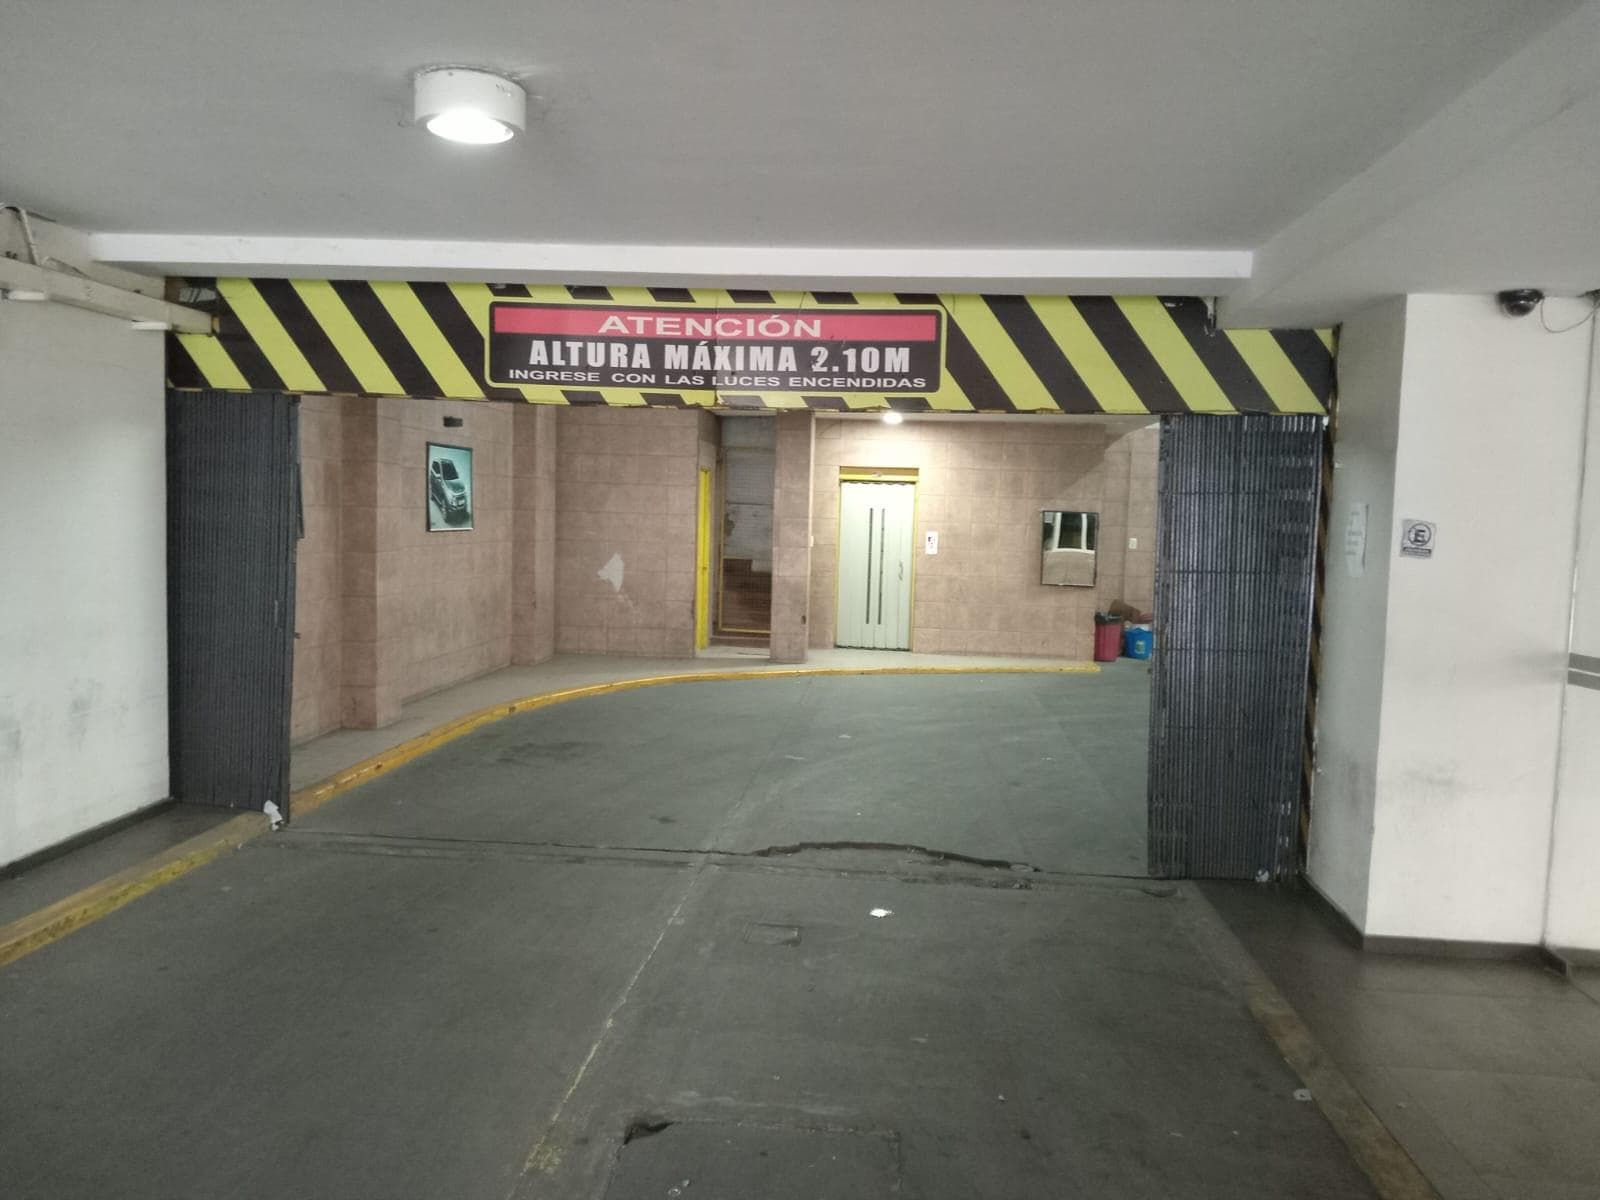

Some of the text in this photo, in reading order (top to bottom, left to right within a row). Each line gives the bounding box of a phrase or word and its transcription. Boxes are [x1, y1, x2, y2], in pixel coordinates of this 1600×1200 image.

[598, 315, 822, 337] ATENCIÓN
[529, 340, 910, 373] ALTURA MÁXIMA 2.10M
[508, 369, 927, 389] INGRESE CON LAS LUCES ENCENDIDAS
[1414, 529, 1426, 543] E
